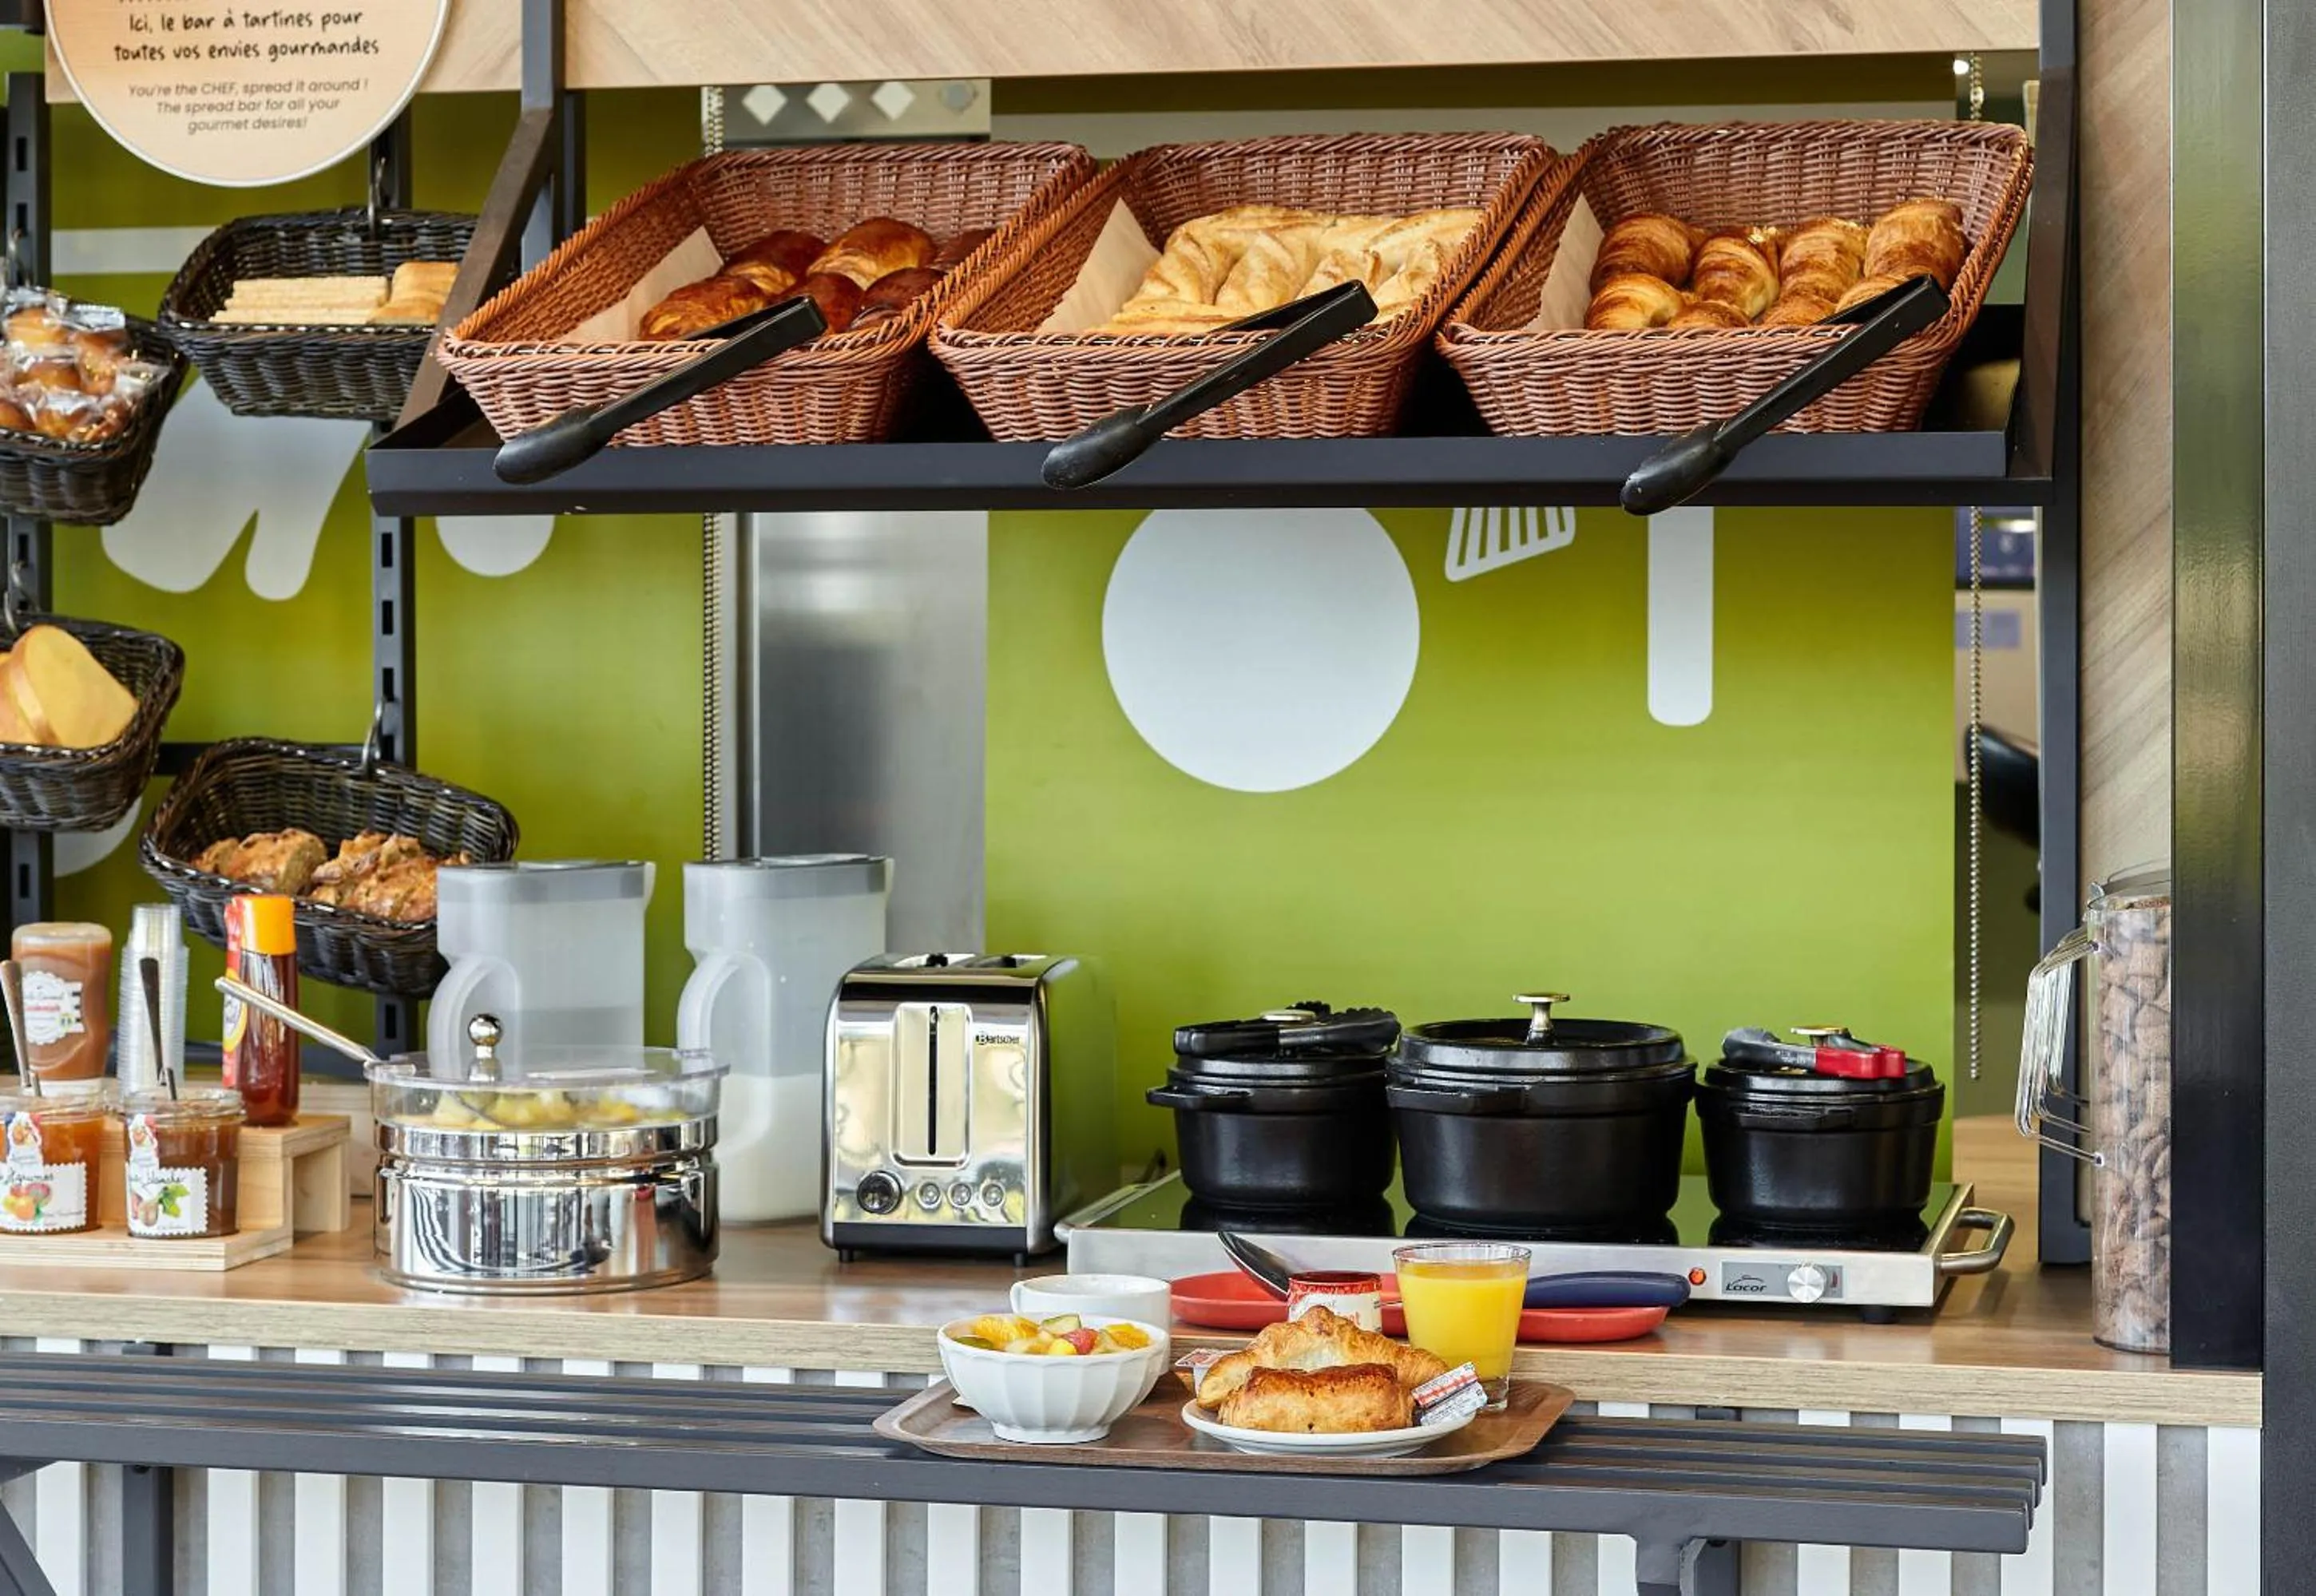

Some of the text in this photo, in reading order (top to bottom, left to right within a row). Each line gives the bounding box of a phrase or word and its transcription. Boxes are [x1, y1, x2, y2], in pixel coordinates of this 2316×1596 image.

[129, 7, 363, 34] Ici, le bar à tartines pour
[113, 36, 379, 62] toutes vos envies gourmandes
[129, 84, 172, 97] You're
[175, 83, 197, 96] the
[200, 81, 239, 96] CHEF,
[244, 81, 292, 96] spread
[295, 80, 305, 93] it
[308, 80, 359, 93] around
[157, 98, 340, 116] The spread bar for all your
[188, 117, 308, 135] gourmet desires!
[1725, 1281, 1767, 1292] Lacor
